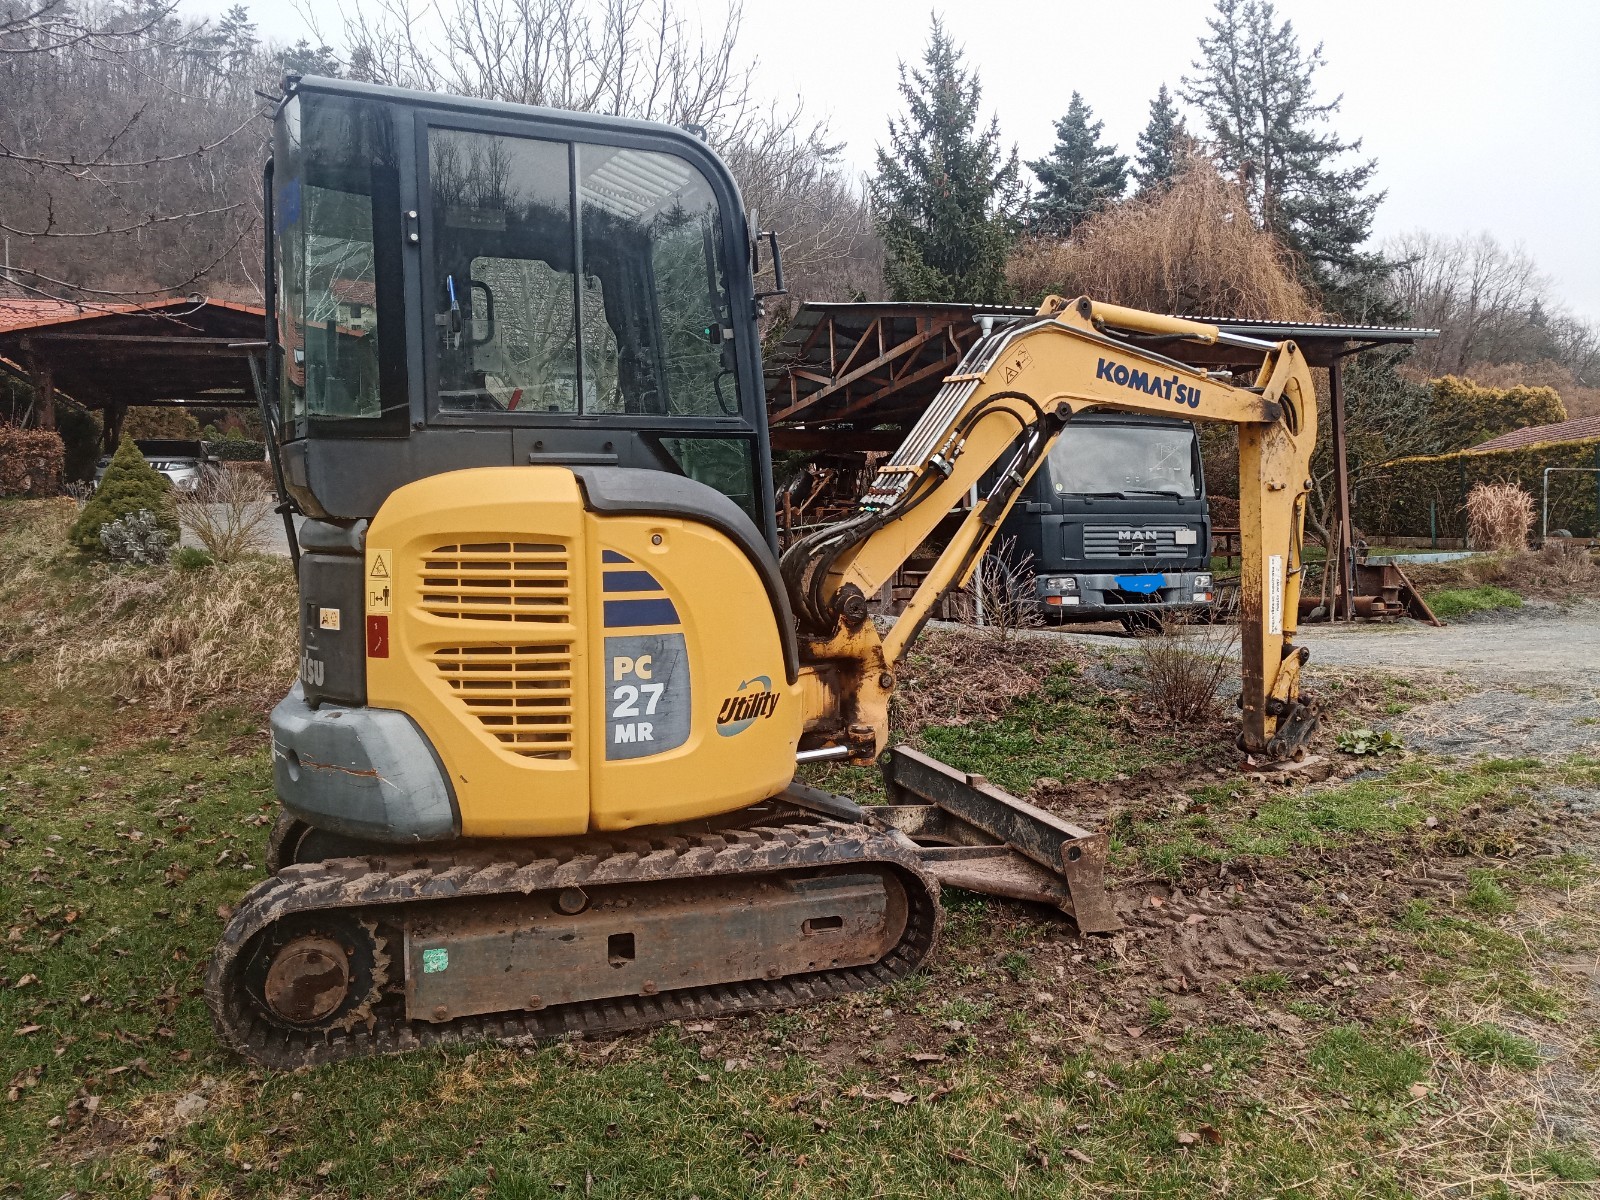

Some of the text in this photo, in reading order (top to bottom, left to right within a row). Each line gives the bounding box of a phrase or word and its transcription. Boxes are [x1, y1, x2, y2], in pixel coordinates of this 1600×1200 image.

[1096, 357, 1201, 409] KOMATSU
[1118, 530, 1157, 540] MAN
[613, 654, 652, 681] PC
[613, 682, 665, 718] 27
[717, 691, 781, 725] Utility
[614, 722, 654, 744] MR
